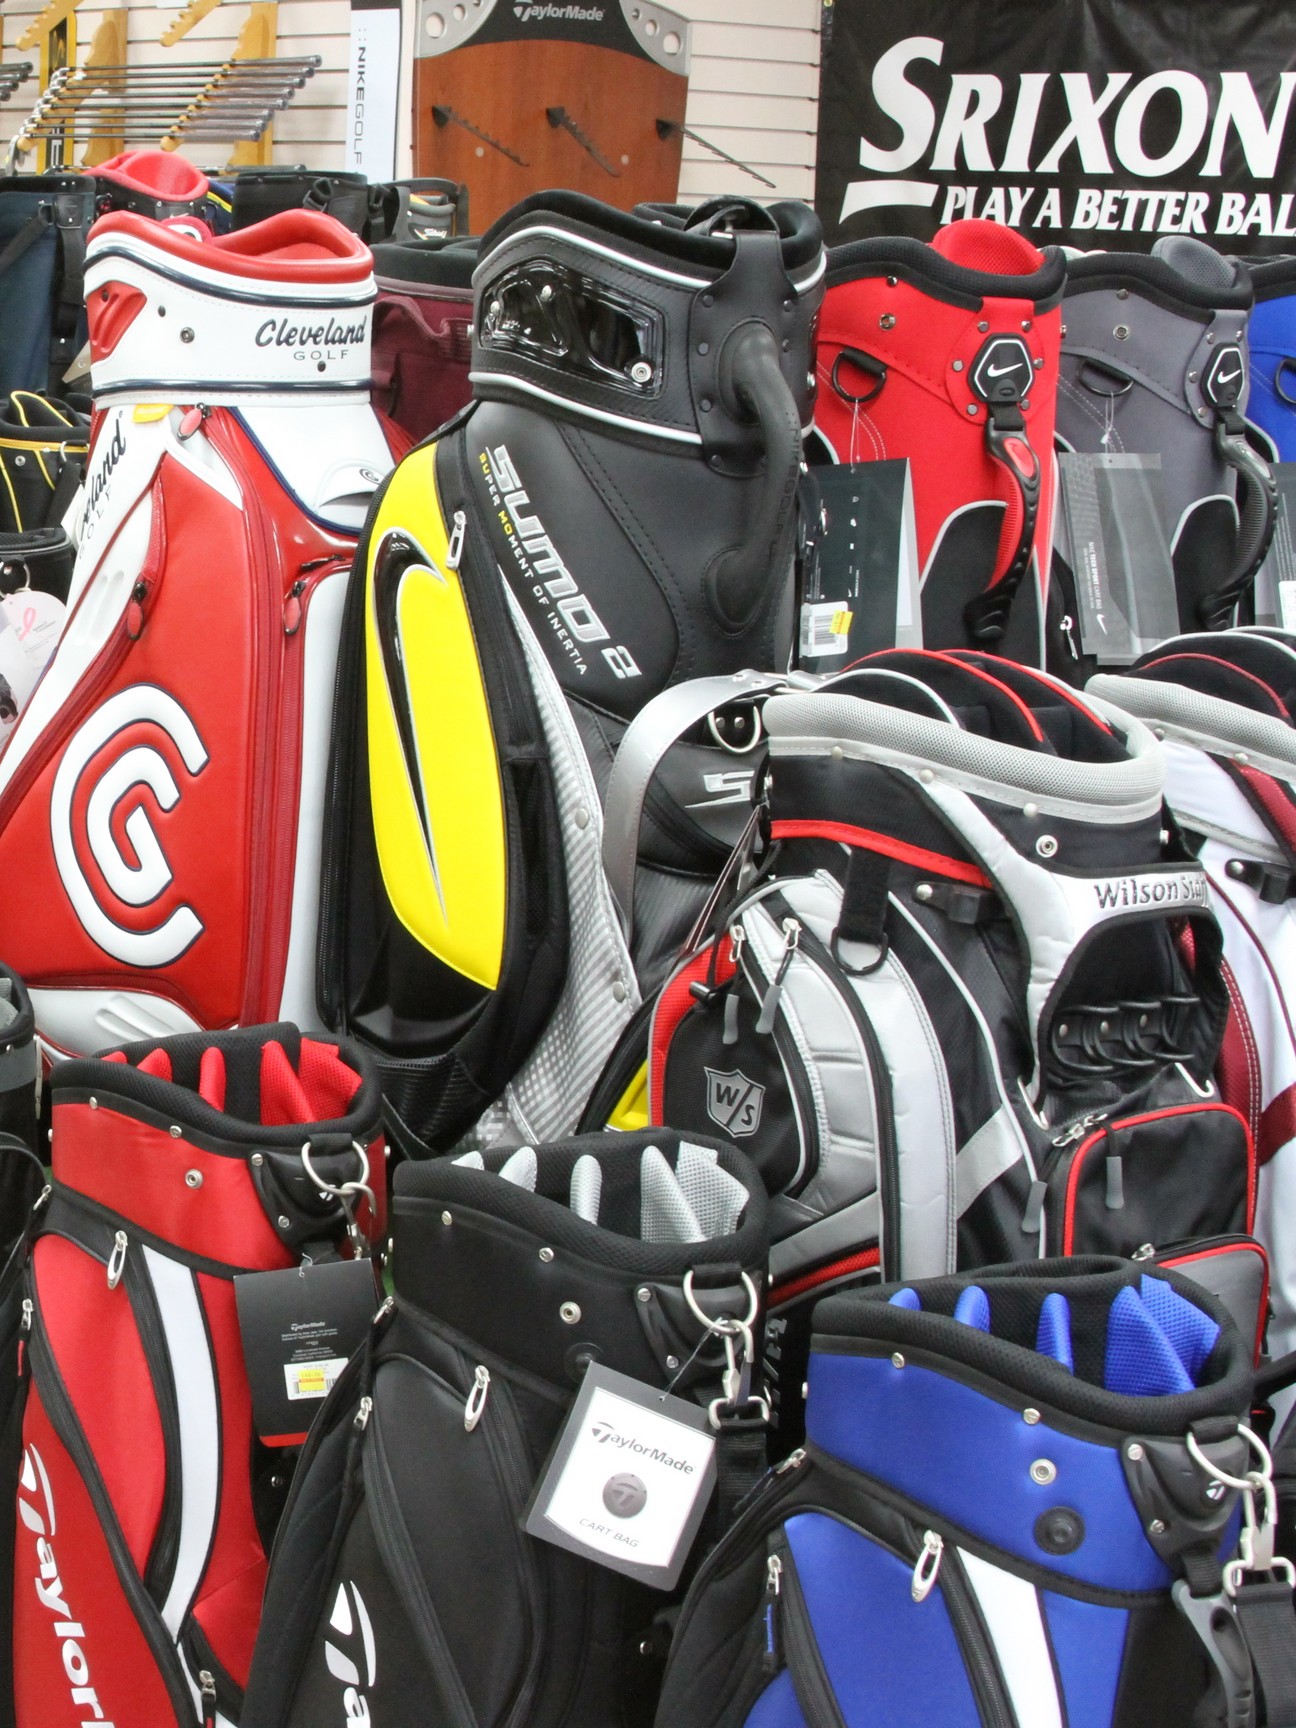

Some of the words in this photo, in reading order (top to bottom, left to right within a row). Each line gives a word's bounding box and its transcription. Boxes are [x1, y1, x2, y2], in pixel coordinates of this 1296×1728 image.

[513, 0, 605, 22] TaylorMade
[859, 36, 1296, 178] SRIXON
[940, 185, 1034, 227] PLAY
[1032, 187, 1063, 229] A
[1071, 189, 1210, 235] BETTER
[255, 314, 367, 348] Cleveland
[293, 349, 349, 361] GOLF
[479, 452, 502, 507] SUPER
[498, 510, 534, 578] MOMENT
[532, 585, 550, 606] OF
[547, 611, 588, 675] INERTIA
[485, 444, 611, 643] SUMO
[1093, 879, 1178, 909] Wilson
[592, 1421, 694, 1475] TaylorMade
[578, 1517, 612, 1537] CART
[613, 1531, 640, 1548] BAG
